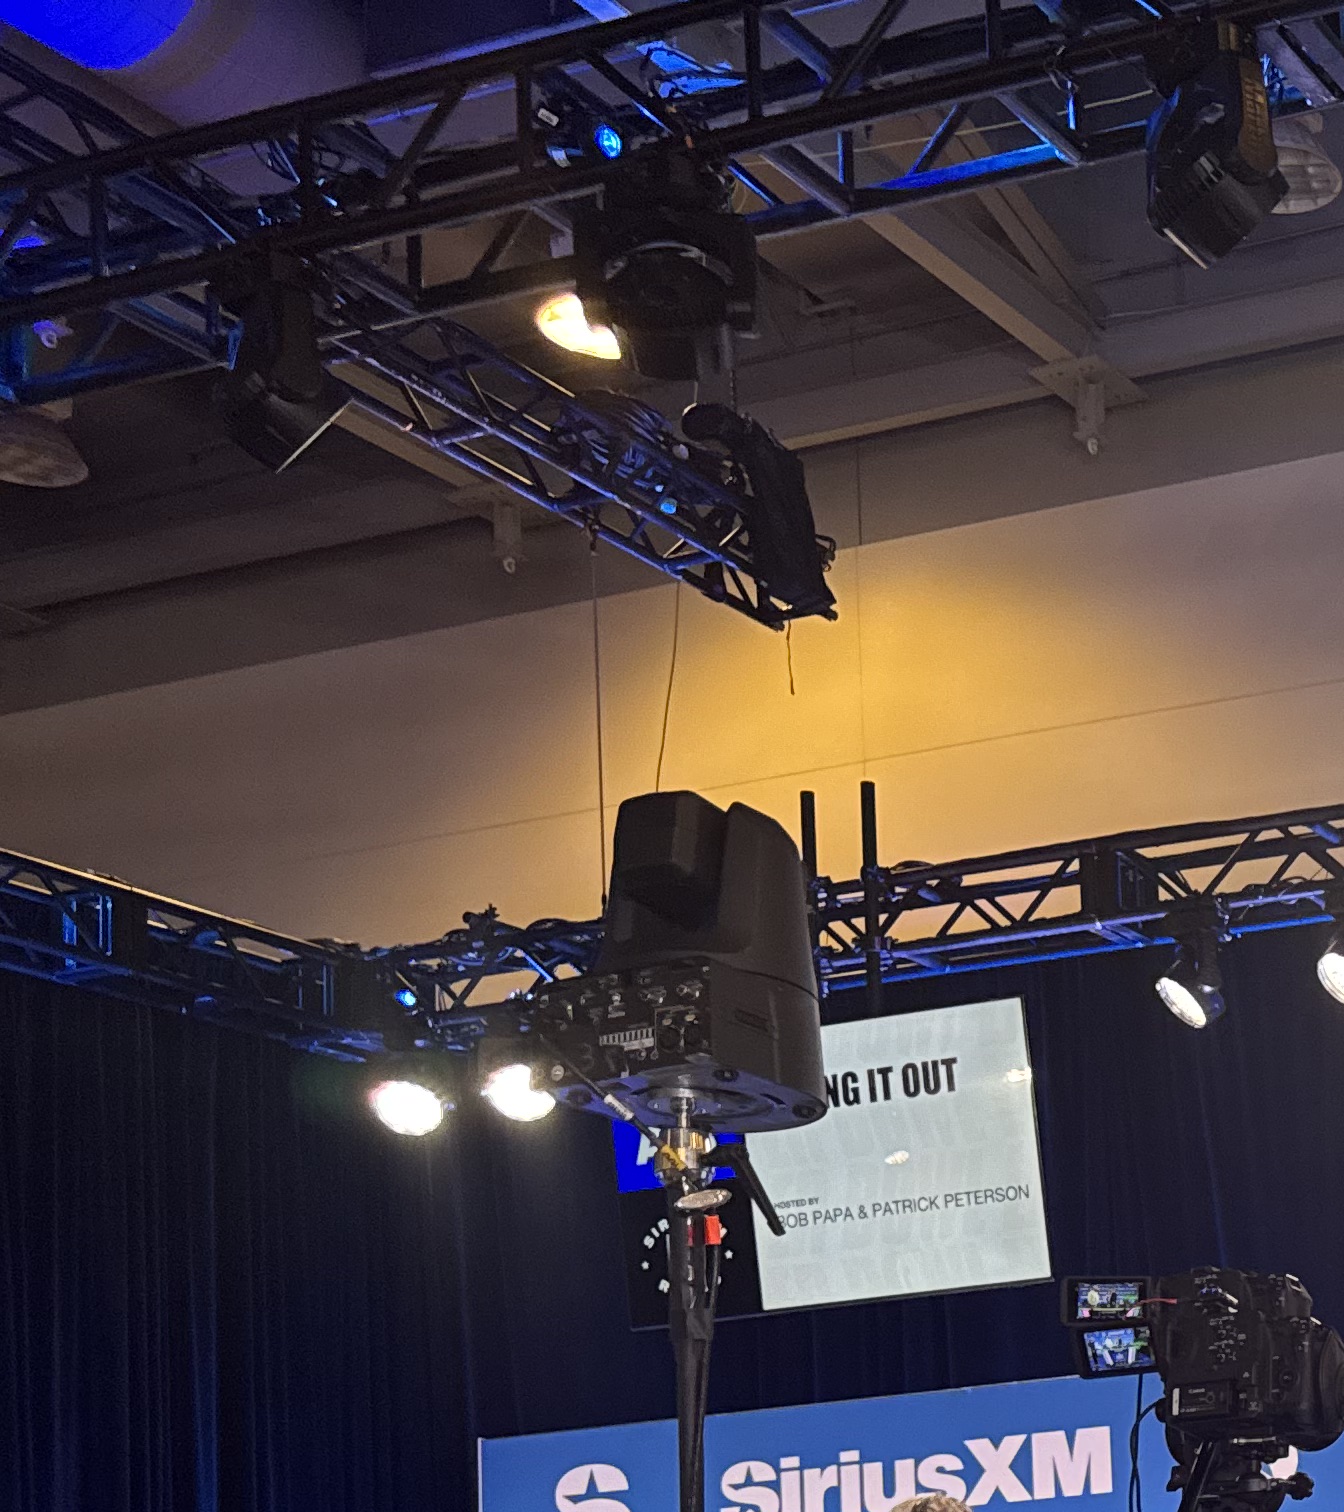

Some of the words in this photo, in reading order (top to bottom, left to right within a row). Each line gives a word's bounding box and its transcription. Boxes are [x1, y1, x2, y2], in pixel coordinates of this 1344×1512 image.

[866, 1065, 894, 1103] IT
[901, 1056, 958, 1098] OUT
[808, 1196, 820, 1206] BY
[812, 1205, 855, 1226] PAPA
[858, 1204, 869, 1220] &
[872, 1195, 940, 1217] PATRICK
[944, 1184, 1030, 1209] PETERSON
